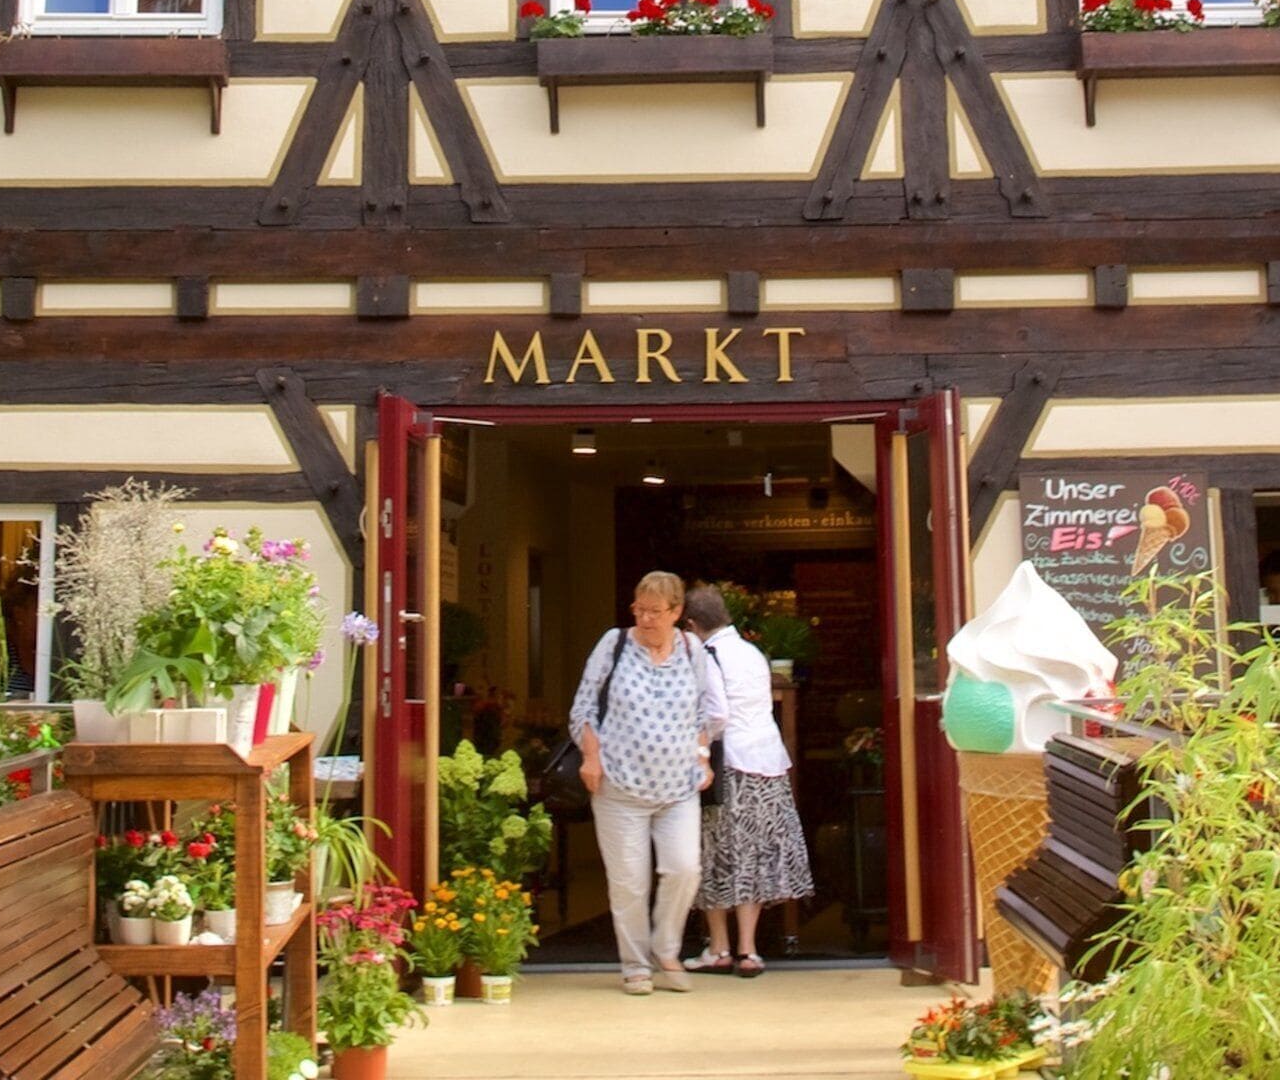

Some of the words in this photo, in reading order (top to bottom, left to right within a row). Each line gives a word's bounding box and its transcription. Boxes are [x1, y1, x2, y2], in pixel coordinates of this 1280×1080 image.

[483, 327, 806, 385] MARKT
[1045, 478, 1125, 501] Unser
[820, 510, 874, 527] einkau
[1025, 504, 1137, 526] Zimmerei
[1051, 526, 1138, 551] Eis!
